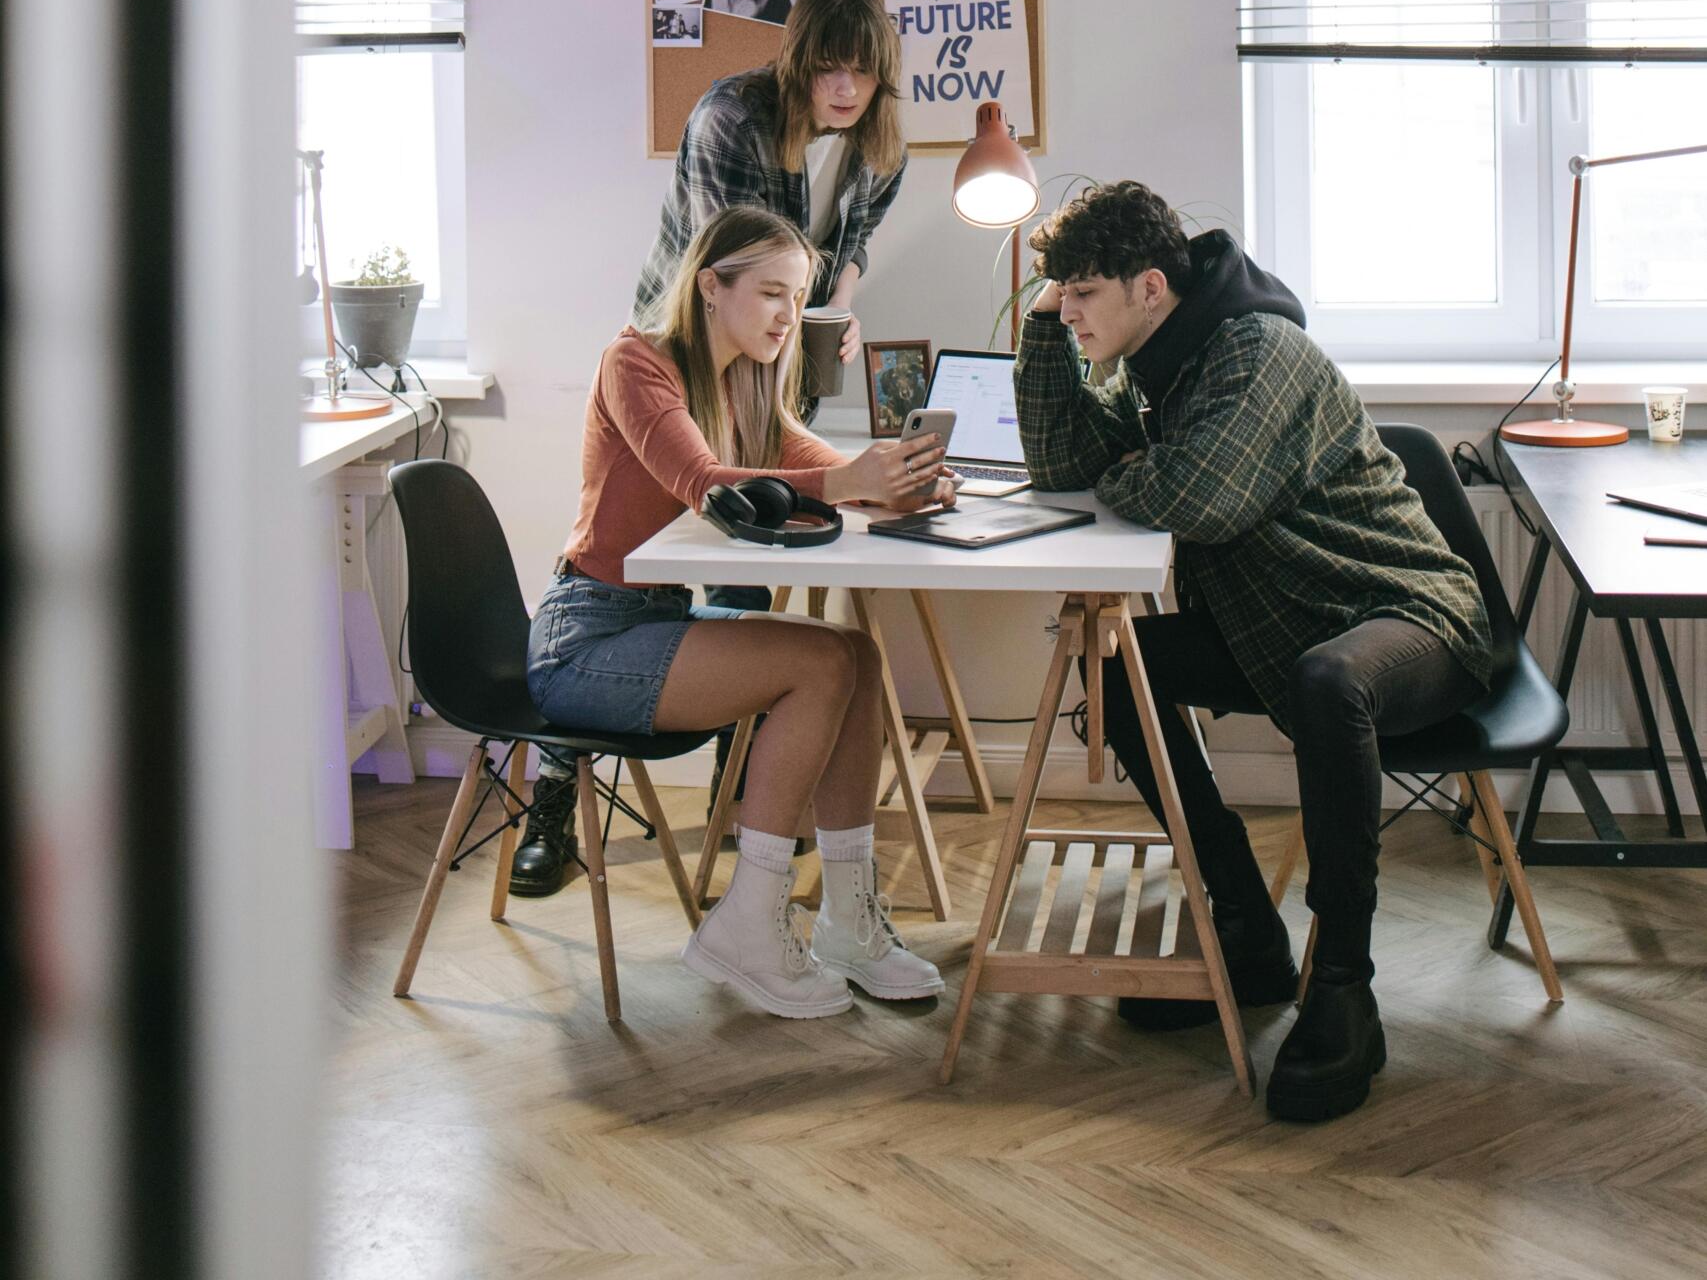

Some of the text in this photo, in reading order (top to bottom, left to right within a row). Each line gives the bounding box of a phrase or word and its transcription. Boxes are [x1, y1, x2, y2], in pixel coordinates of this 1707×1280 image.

[899, 0, 1012, 35] FUTURE
[936, 35, 973, 69] IS
[912, 70, 1005, 102] NOW
